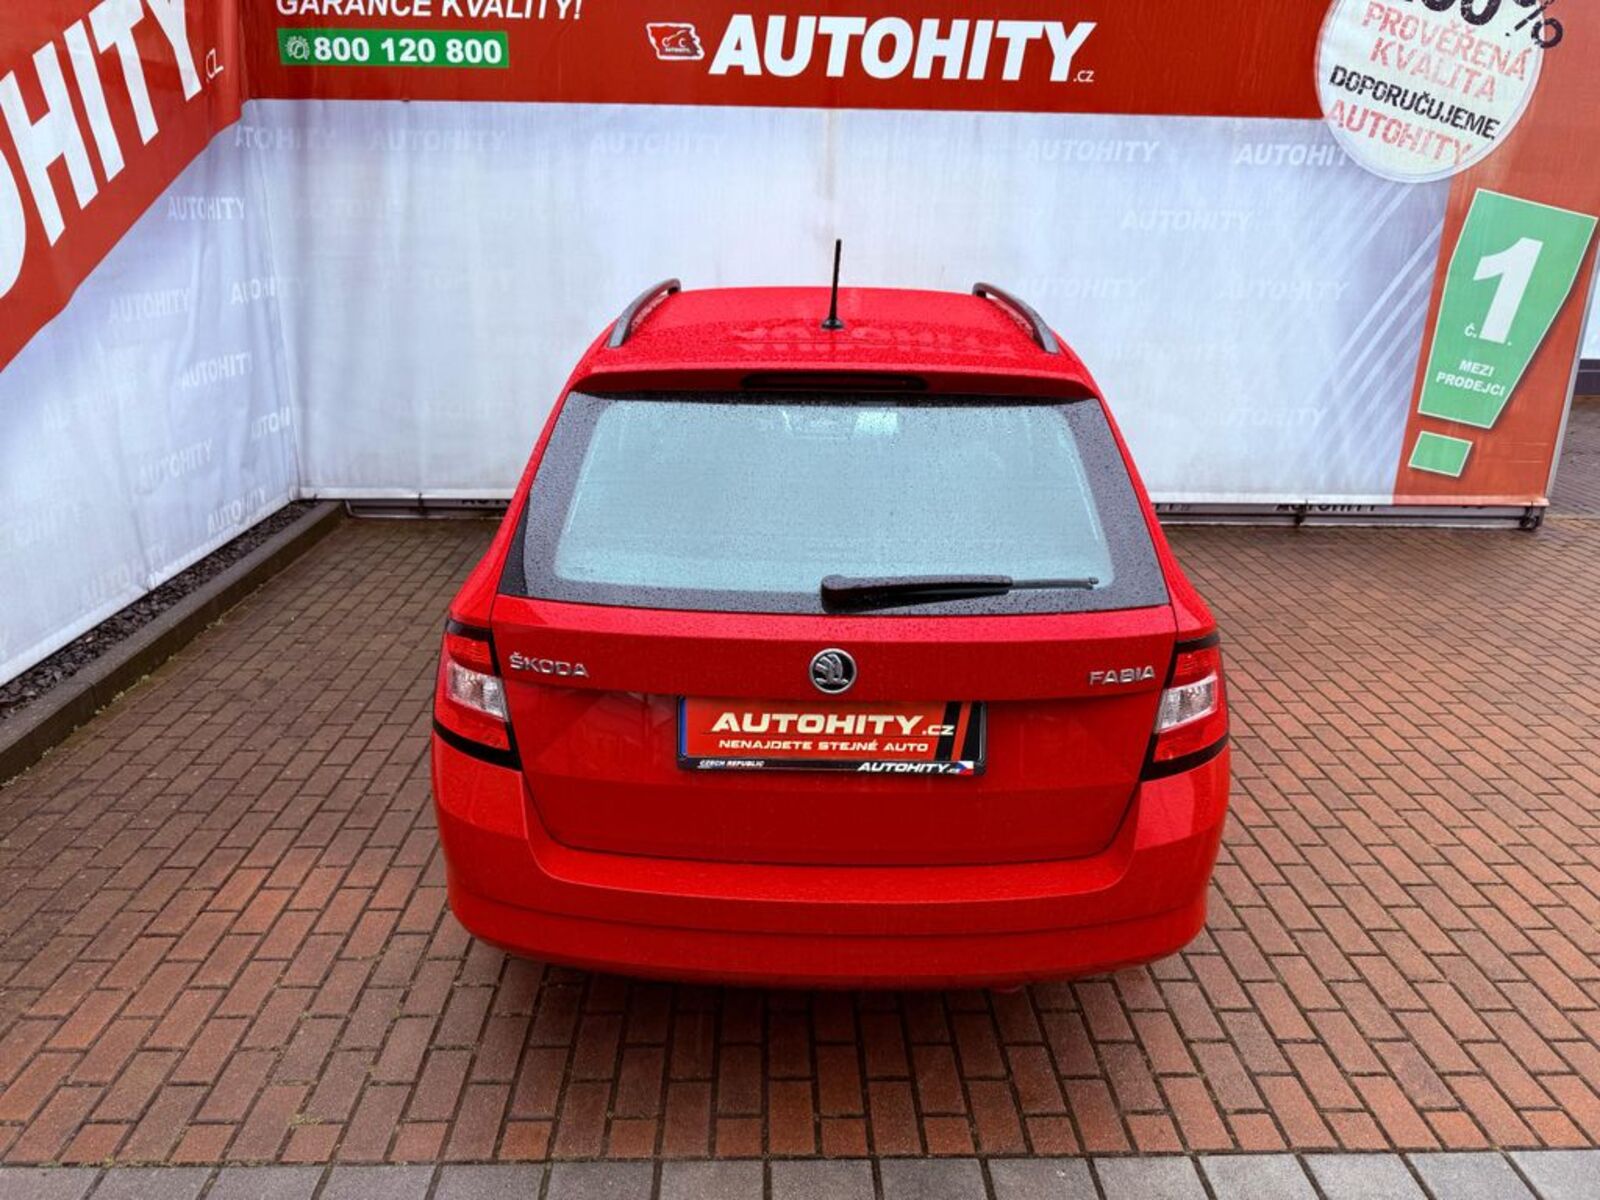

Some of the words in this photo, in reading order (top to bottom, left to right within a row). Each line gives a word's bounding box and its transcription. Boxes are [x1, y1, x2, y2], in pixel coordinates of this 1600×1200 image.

[276, 0, 432, 16] GARANCE
[441, 0, 583, 20] KVALITY!
[314, 37, 370, 61] 800
[380, 38, 436, 63] 120
[446, 39, 502, 64] 800
[1362, 2, 1533, 81] PROVĚŘENÁ
[1370, 37, 1496, 102] KVALITA
[1329, 65, 1501, 140] DOPORUČUJEME
[1326, 99, 1473, 165] AUTOHITY
[1026, 140, 1160, 164] AUTOHITY
[1235, 143, 1351, 166] AUTOHIT
[167, 196, 246, 221] AUTOHITY
[1120, 208, 1253, 232] AUTOHITY
[108, 288, 191, 324] AUTOHITY
[1459, 359, 1494, 377] MEZI
[1435, 371, 1506, 397] PRODEJCI
[509, 651, 590, 678] ŠKODA
[1089, 665, 1156, 686] FABIA
[718, 738, 812, 751] NENAJDETE
[817, 740, 878, 752] STEJNÉ
[882, 742, 929, 753] AUTO
